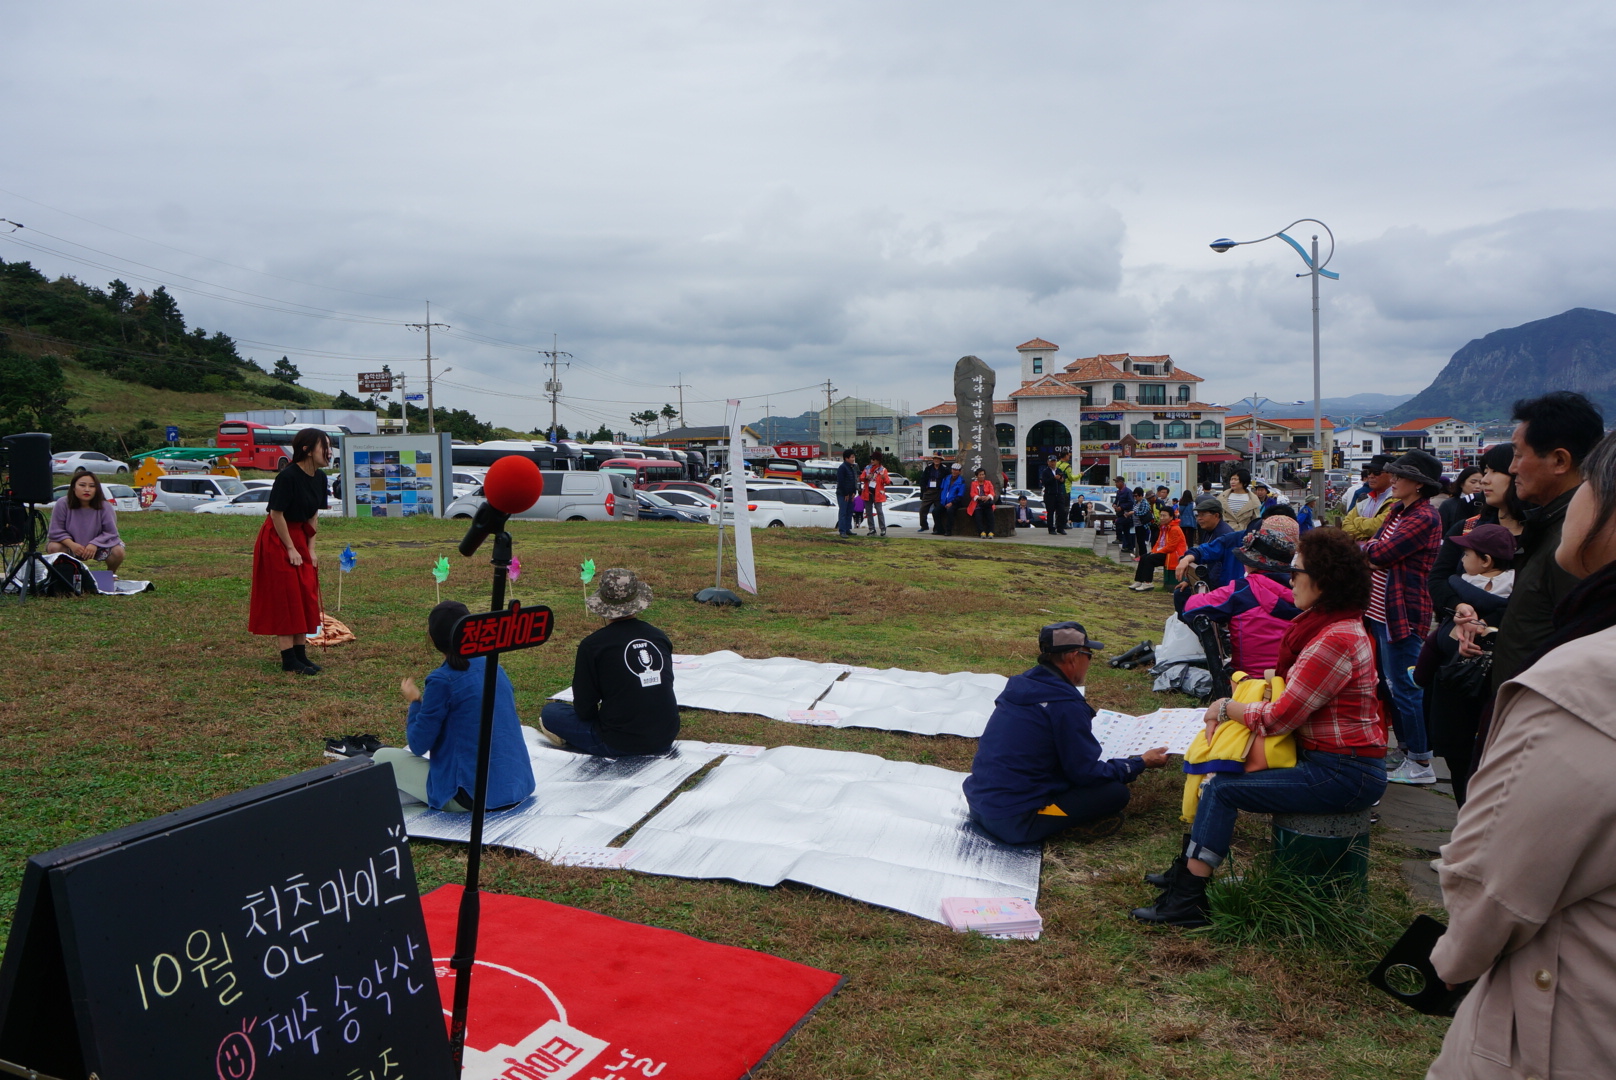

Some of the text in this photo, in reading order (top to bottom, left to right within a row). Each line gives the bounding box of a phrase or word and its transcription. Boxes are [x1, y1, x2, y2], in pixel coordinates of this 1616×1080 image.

[780, 446, 809, 457] 편의점
[458, 605, 550, 655] 청춘마이크
[632, 642, 648, 650] STAFF
[134, 846, 407, 1011] 10월 청춘마이크
[261, 990, 319, 1056] 제주
[334, 934, 425, 1044] 송악산
